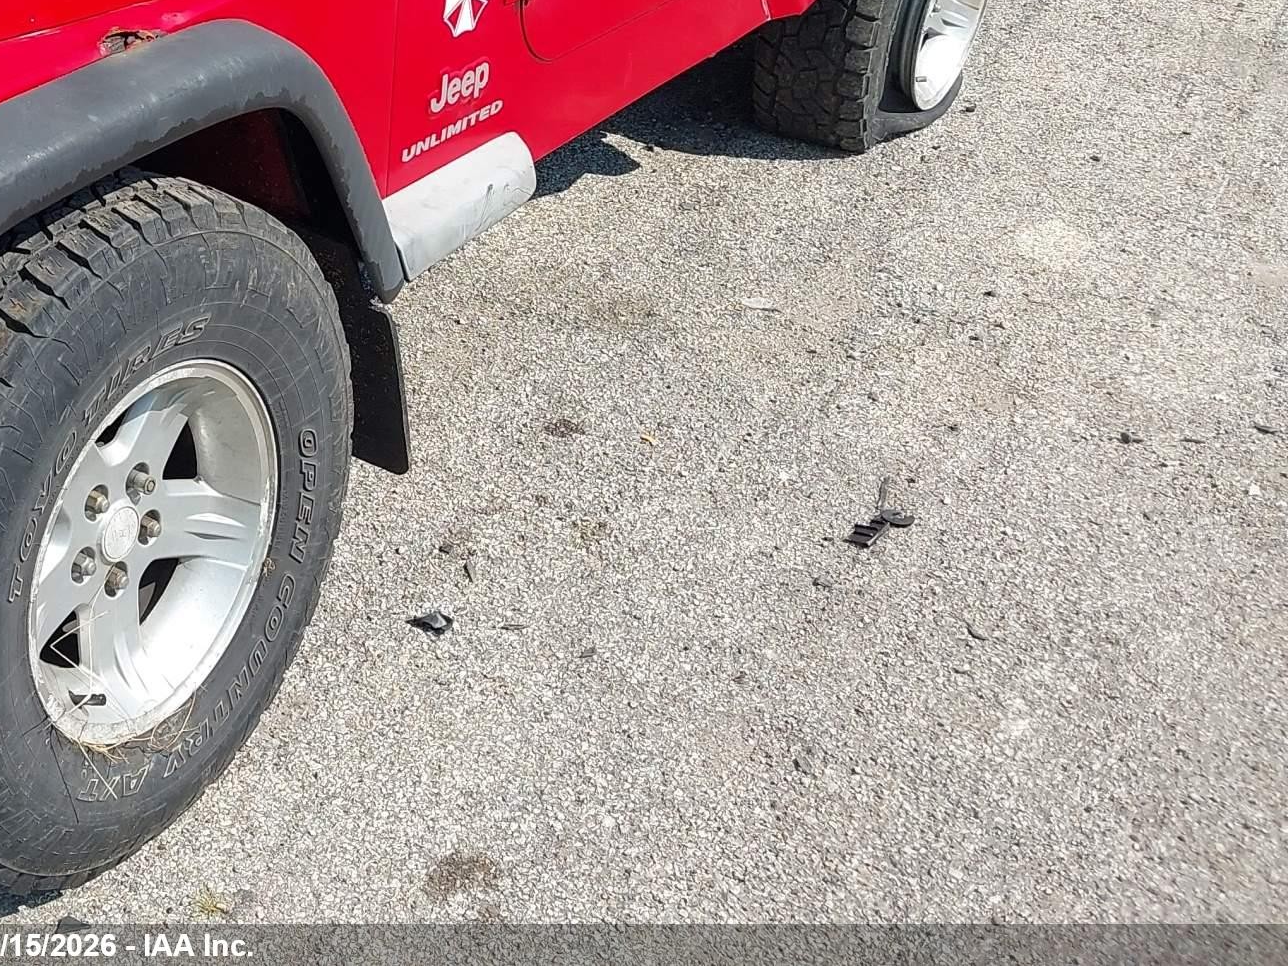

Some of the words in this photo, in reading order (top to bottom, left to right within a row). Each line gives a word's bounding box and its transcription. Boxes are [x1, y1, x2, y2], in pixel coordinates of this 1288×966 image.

[401, 100, 503, 163] UNLIMITED
[430, 62, 490, 113] Jeep
[8, 430, 77, 603] TOYO
[82, 316, 211, 426] TIRES
[288, 428, 319, 565] OPEN
[163, 573, 296, 779] COUNTRY
